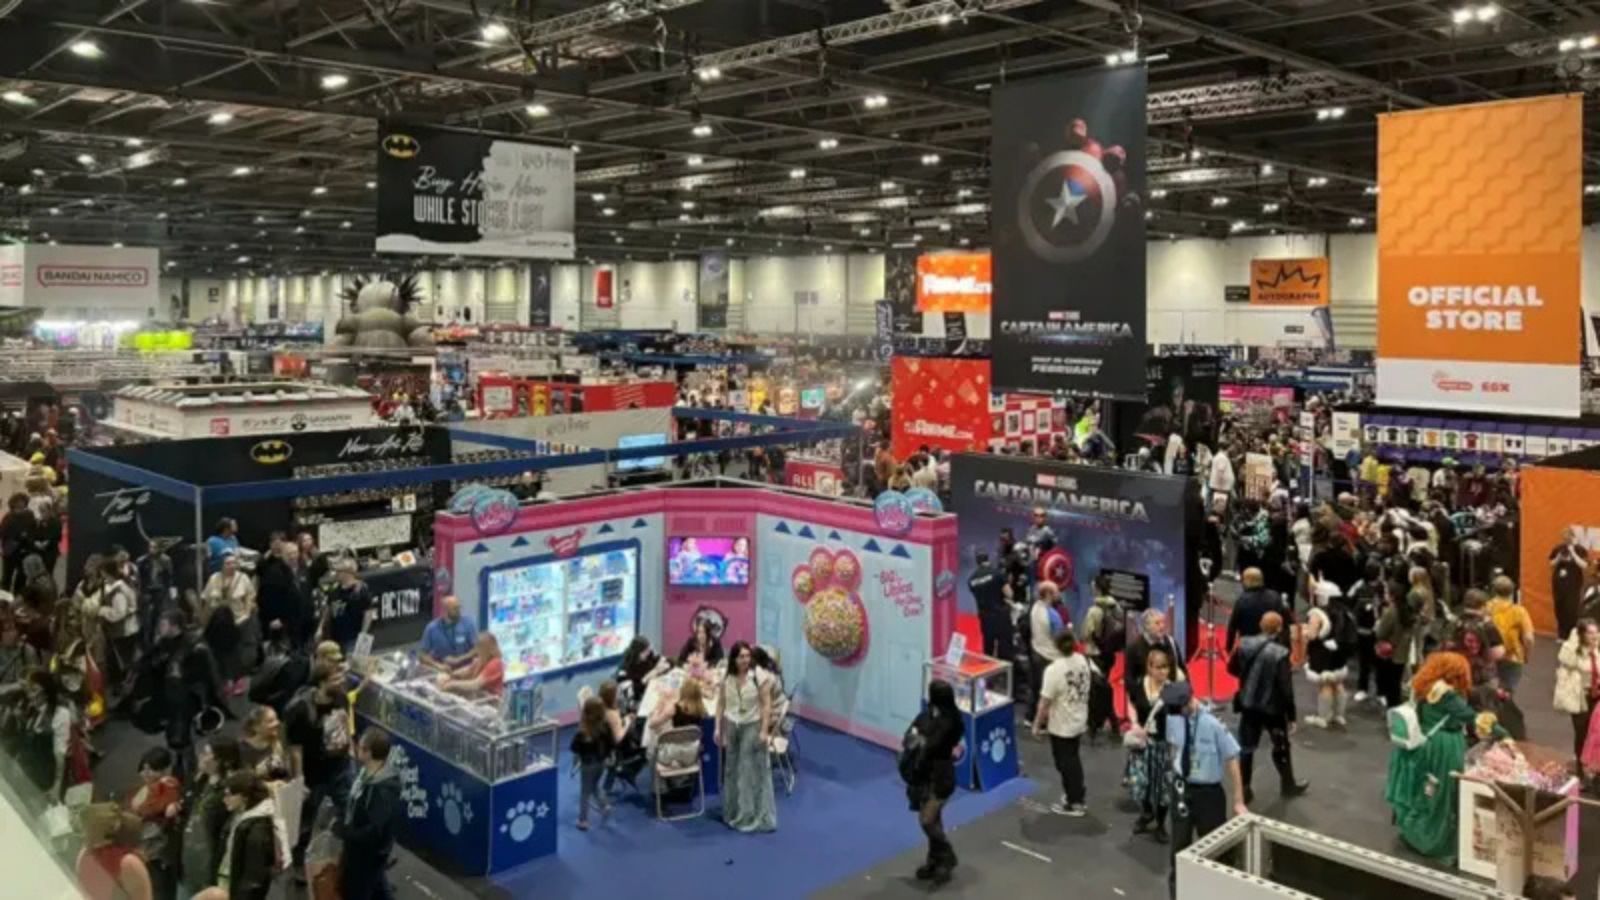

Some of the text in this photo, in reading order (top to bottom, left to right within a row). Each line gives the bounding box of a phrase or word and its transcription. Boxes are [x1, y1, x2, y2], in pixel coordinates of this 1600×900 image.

[413, 165, 454, 194] Buy
[413, 195, 456, 225] WHILE
[44, 271, 91, 281] BANDAI
[1407, 286, 1544, 307] OFFICIAL
[1000, 320, 1135, 338] CAPTAIN AMERICA
[1426, 309, 1523, 331] STORE
[1031, 364, 1100, 376] FEBRUARY
[974, 479, 1052, 501] CAPTAIN
[1051, 490, 1150, 523] AMERICA
